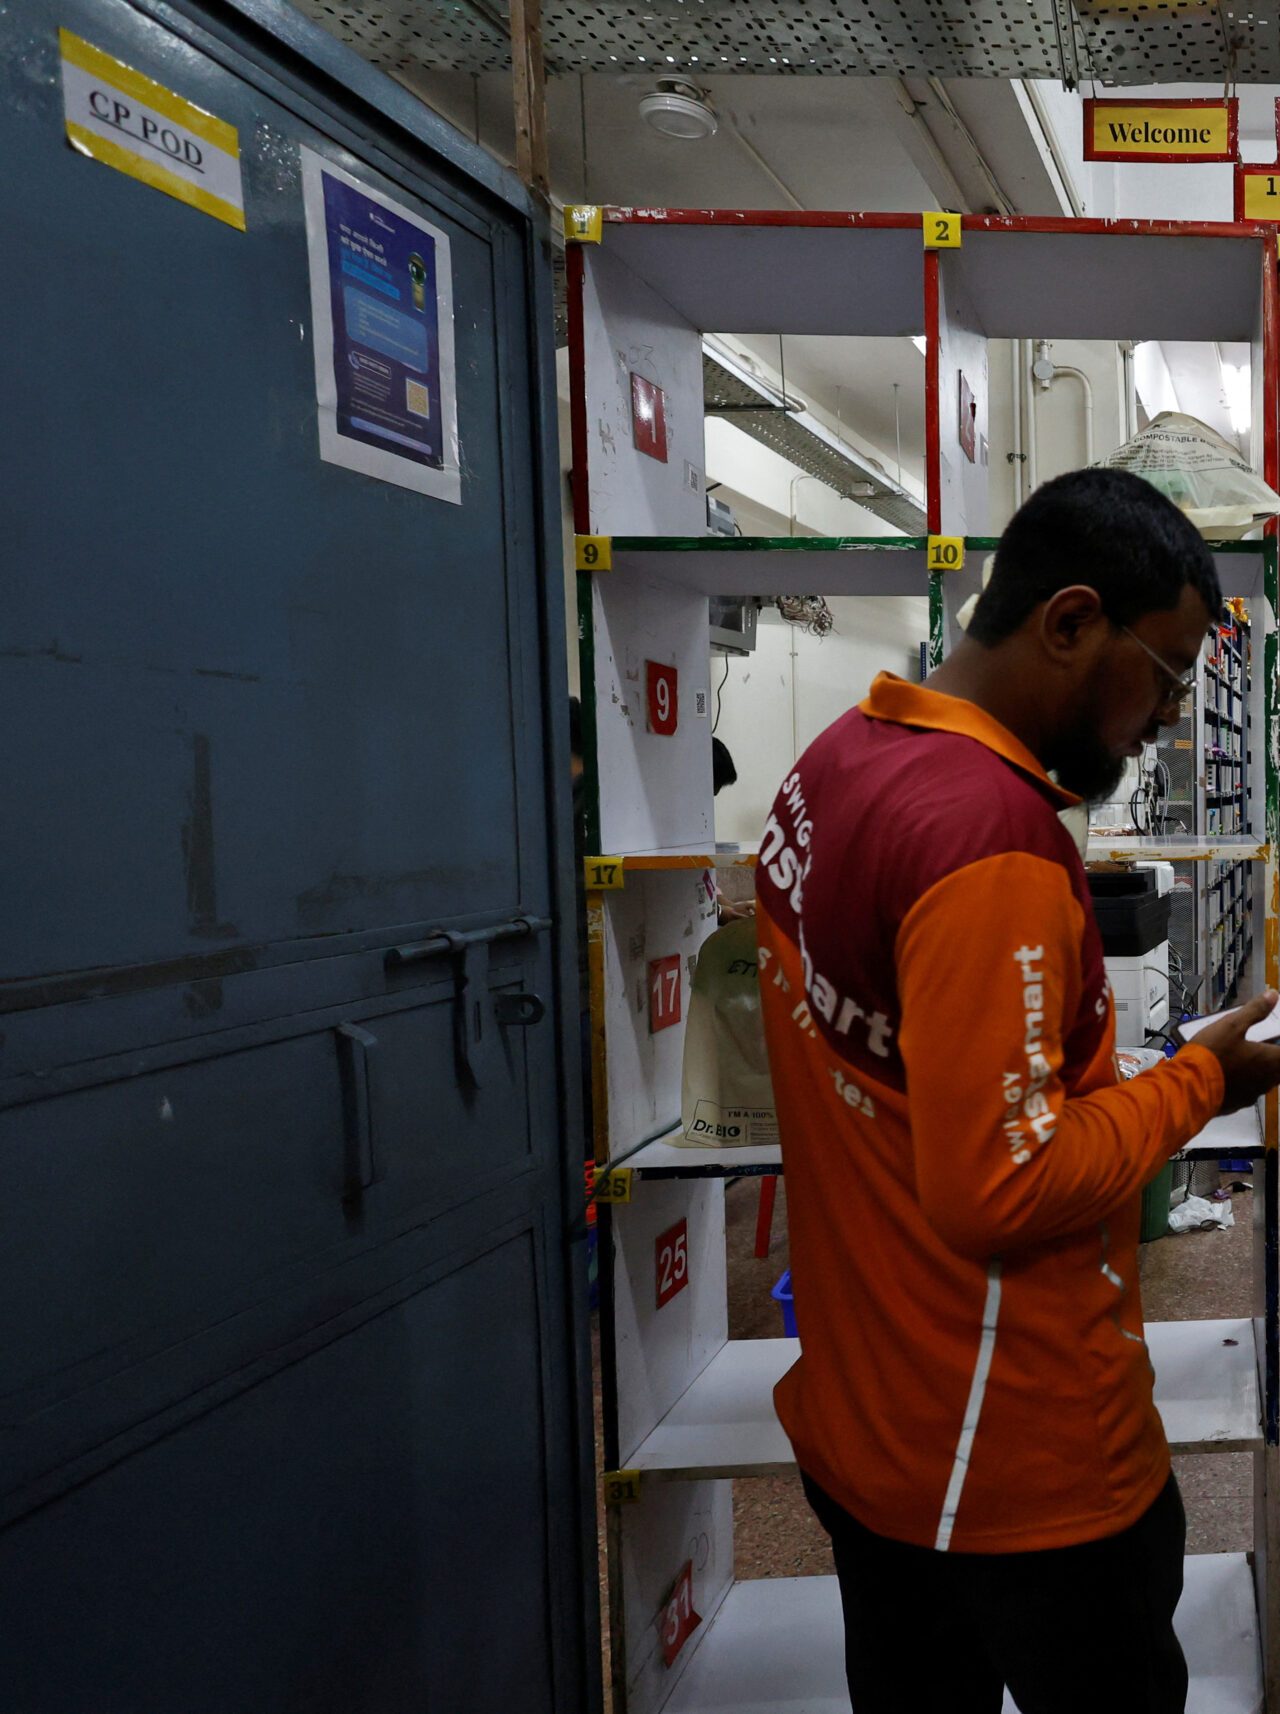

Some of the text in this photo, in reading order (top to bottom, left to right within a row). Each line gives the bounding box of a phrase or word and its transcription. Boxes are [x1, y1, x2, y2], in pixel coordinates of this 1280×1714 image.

[89, 90, 204, 168] CP POD
[1108, 121, 1212, 145] Welcome
[576, 213, 590, 234] 1
[934, 219, 950, 241] 2
[1134, 433, 1198, 443] COMPOSTABLE
[582, 543, 599, 564] 9
[931, 544, 957, 565] 10
[656, 678, 670, 722] 9
[591, 866, 616, 885] 17
[652, 969, 678, 1018] 17
[752, 1111, 774, 1119] 100%
[599, 1177, 627, 1198] 25
[660, 1237, 687, 1293] 25
[610, 1480, 636, 1500] 31
[666, 1577, 690, 1645] 31
